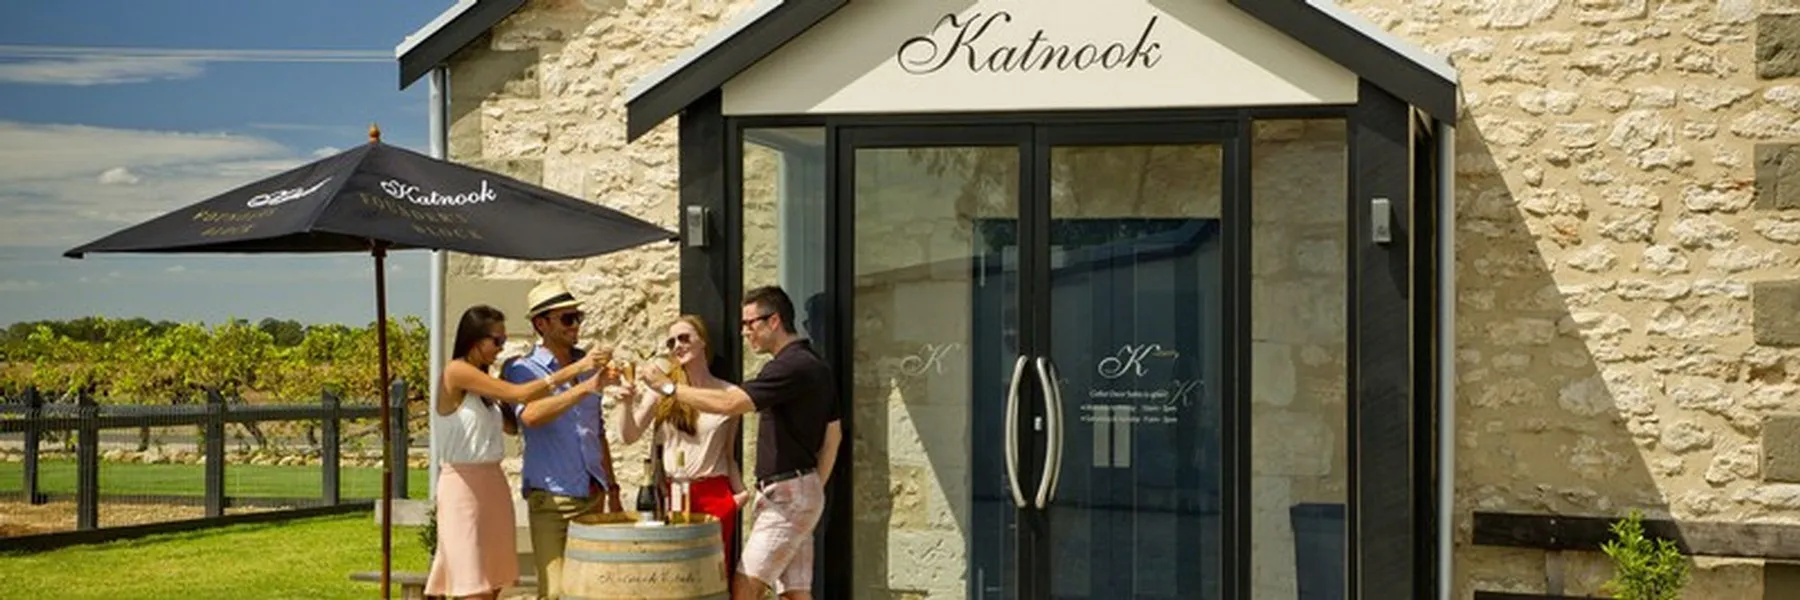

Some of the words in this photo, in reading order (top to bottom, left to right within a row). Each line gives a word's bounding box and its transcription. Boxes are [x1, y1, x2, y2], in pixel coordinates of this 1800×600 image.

[897, 11, 1162, 75] Katnook
[380, 179, 497, 206] Katnook
[1098, 344, 1161, 379] K
